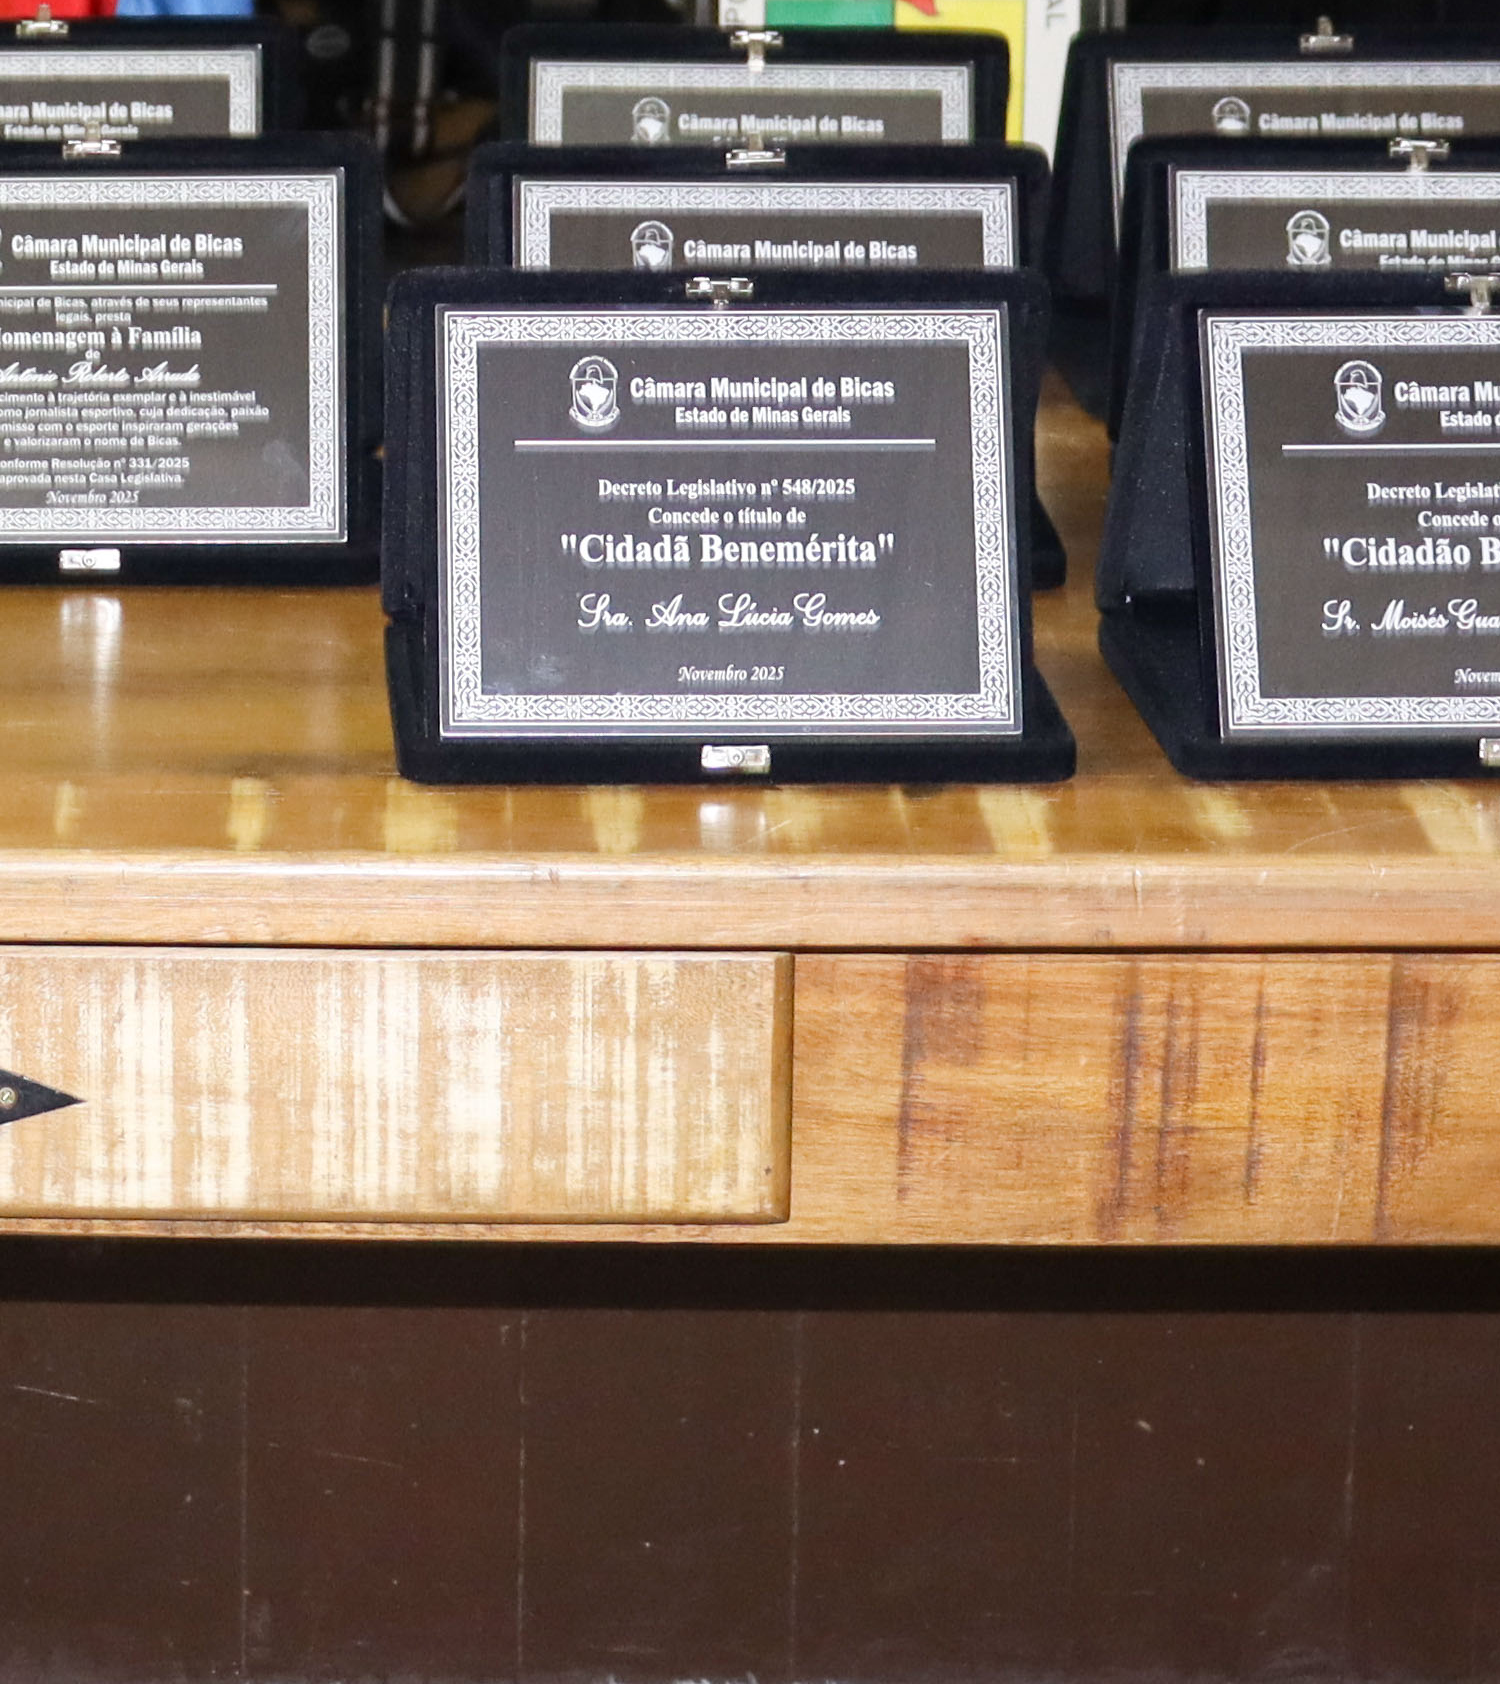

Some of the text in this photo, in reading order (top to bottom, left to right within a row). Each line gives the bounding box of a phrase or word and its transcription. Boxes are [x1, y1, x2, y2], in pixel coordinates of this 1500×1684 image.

[32, 102, 106, 121] Municipal
[109, 102, 128, 118] de
[131, 102, 173, 118] Bicas
[678, 114, 884, 133] Câmara Municipal de Bicas
[1258, 113, 1464, 131] Câmara Municipal de Bicas
[12, 234, 242, 255] Câmara Municipal de Bicas
[1340, 229, 1406, 248] Câmara
[1411, 230, 1495, 251] Municipal
[684, 239, 917, 262] Câmara Municipal de Bicas
[51, 260, 203, 274] Estado de Minas Gerais
[111, 328, 122, 344] à
[129, 327, 201, 344] Família
[86, 349, 99, 359] de
[48, 392, 55, 402] à
[58, 392, 109, 404] trajetória
[113, 392, 166, 404] exemplar
[169, 394, 176, 402] e
[179, 392, 186, 401] à
[189, 391, 256, 401] inestimável
[631, 377, 894, 402] Câmara Municipal de Bicas
[1395, 382, 1469, 403] Câmara
[24, 407, 78, 418] jornalista
[139, 407, 163, 418] cuja
[231, 406, 269, 417] paixão
[676, 407, 850, 423] Estado de Minas Gerais
[1441, 412, 1491, 427] Estado
[38, 422, 62, 431] com
[66, 423, 72, 431] o
[76, 422, 118, 433] esporte
[122, 421, 183, 432] inspiraram
[186, 420, 238, 432] gerações
[4, 438, 11, 446] e
[14, 437, 81, 446] valorizaram
[130, 436, 144, 445] de
[47, 491, 139, 504] Novembro 2025
[599, 479, 662, 496] Decreto
[667, 479, 756, 499] Legislativo
[782, 478, 855, 495] 548/2025
[1368, 482, 1430, 500] Decreto
[649, 507, 806, 524] Concede o título de
[1418, 511, 1488, 527] Concede
[561, 533, 894, 563] "Cidadã Benemérita"
[1324, 538, 1470, 567] "Cidadão
[578, 593, 880, 627] Sra. Ana Lúcia Gomes
[1322, 600, 1360, 631] Sr.
[1371, 600, 1448, 630] Moisés
[678, 665, 784, 682] Novembro 2025
